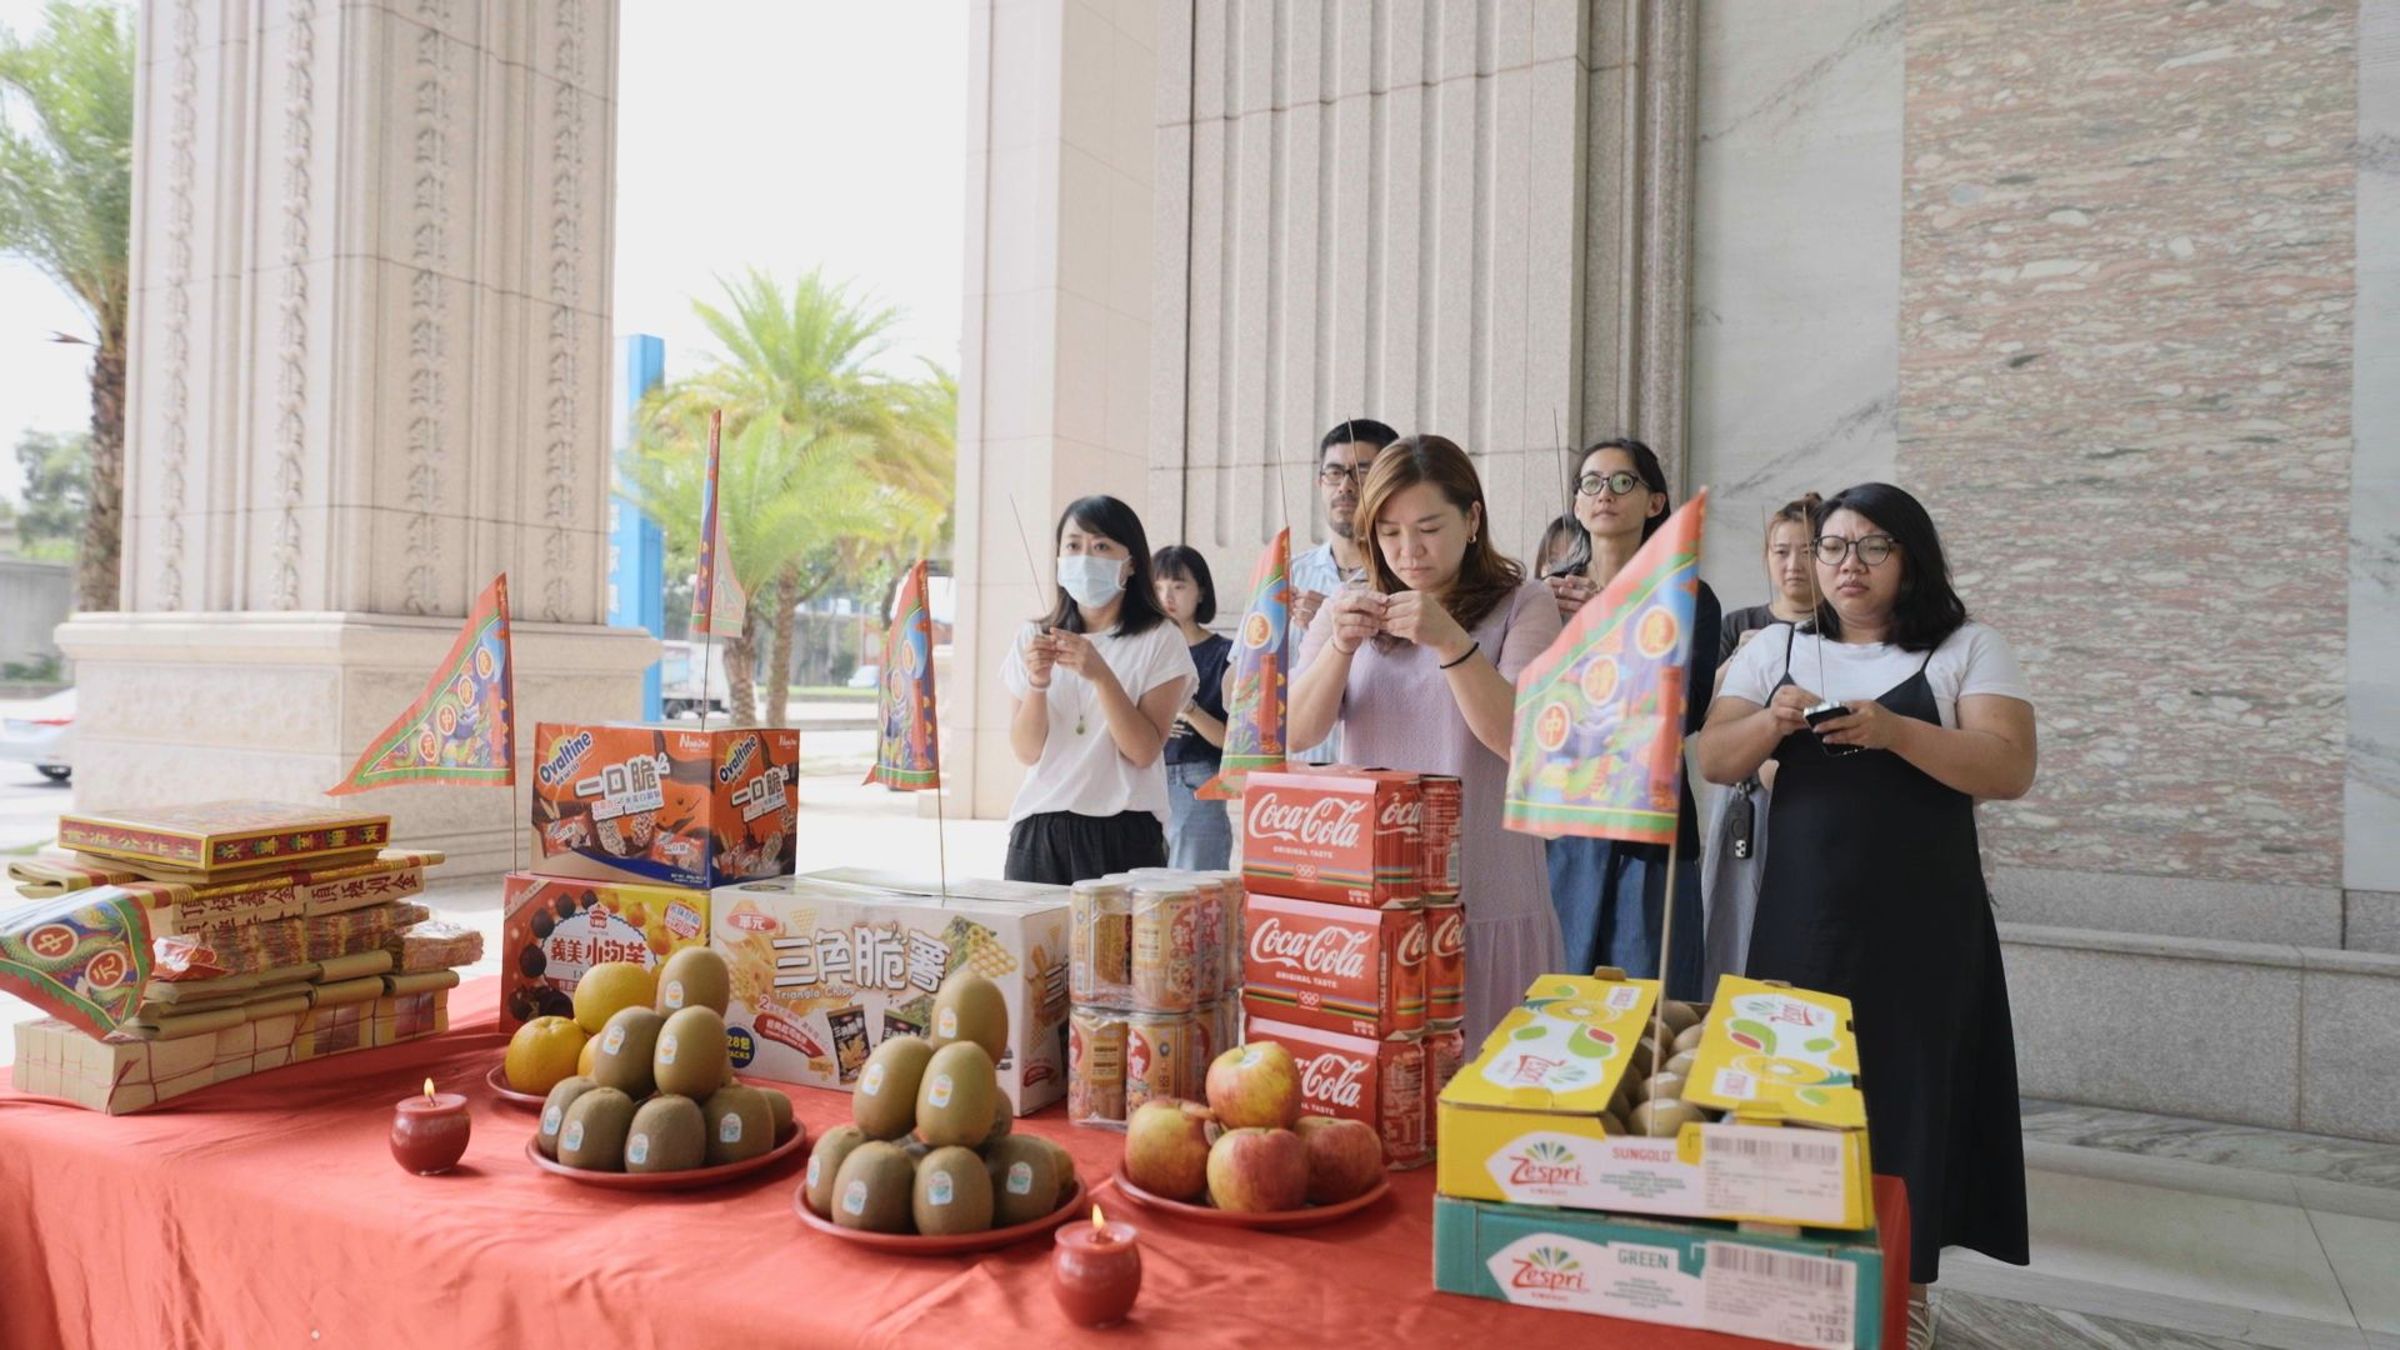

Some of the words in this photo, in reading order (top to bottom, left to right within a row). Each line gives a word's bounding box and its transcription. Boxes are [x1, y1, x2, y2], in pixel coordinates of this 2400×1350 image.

[540, 731, 592, 783] Ovaltine
[719, 735, 759, 783] Ovaltine
[577, 758, 660, 797] 一口脆
[733, 771, 785, 804] 一口脆
[1248, 793, 1368, 848] Coca-Cola
[1310, 850, 1334, 859] TASTE
[739, 916, 766, 931] 華元
[772, 921, 950, 993] 三角脆薯
[1250, 918, 1373, 979] Coca-Cola
[1276, 971, 1311, 984] ORIGINAL
[1313, 977, 1338, 989] TASTE
[1311, 1104, 1335, 1116] TASTE
[1508, 1156, 1585, 1186] Zespri
[1612, 1147, 1671, 1163] SUNGOLD
[1511, 1258, 1587, 1290] Zespri
[1617, 1249, 1669, 1269] GREEN
